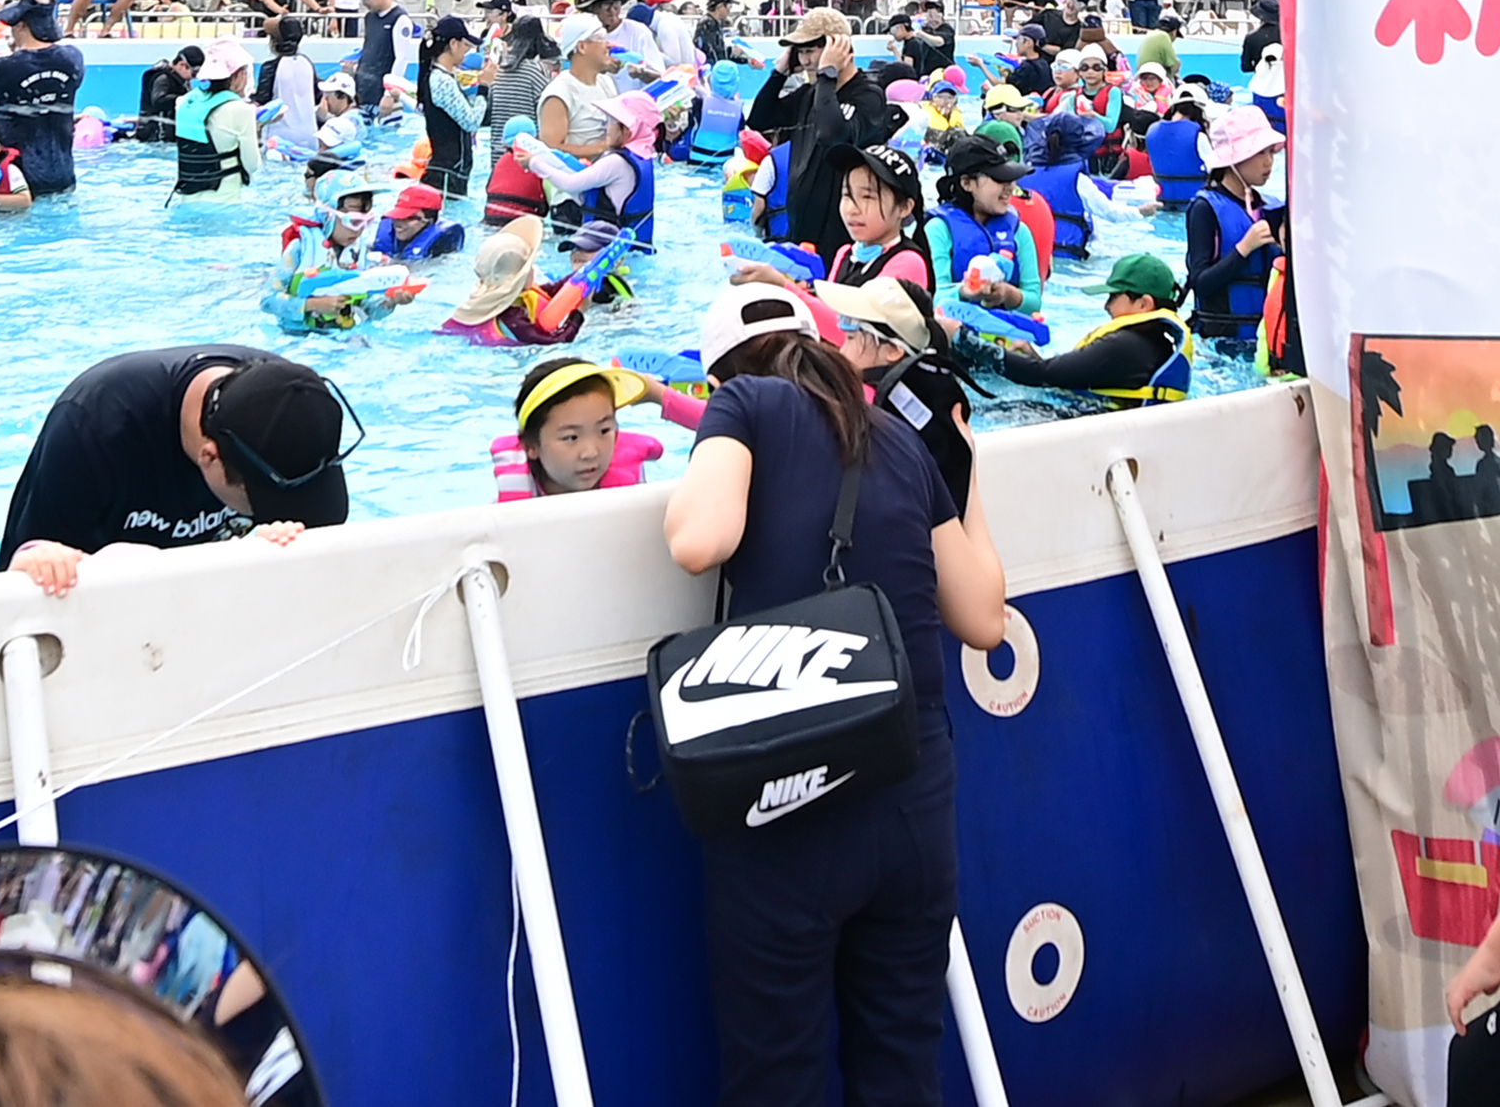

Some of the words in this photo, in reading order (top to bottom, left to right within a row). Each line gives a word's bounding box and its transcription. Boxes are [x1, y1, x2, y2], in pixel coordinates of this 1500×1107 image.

[123, 509, 171, 532] new
[171, 505, 238, 539] balan
[683, 624, 869, 691] NIKE
[988, 690, 1029, 714] CAUTION
[759, 765, 829, 811] NIKE
[1023, 908, 1063, 934] SUCTION
[1026, 992, 1067, 1018] CAUTION
